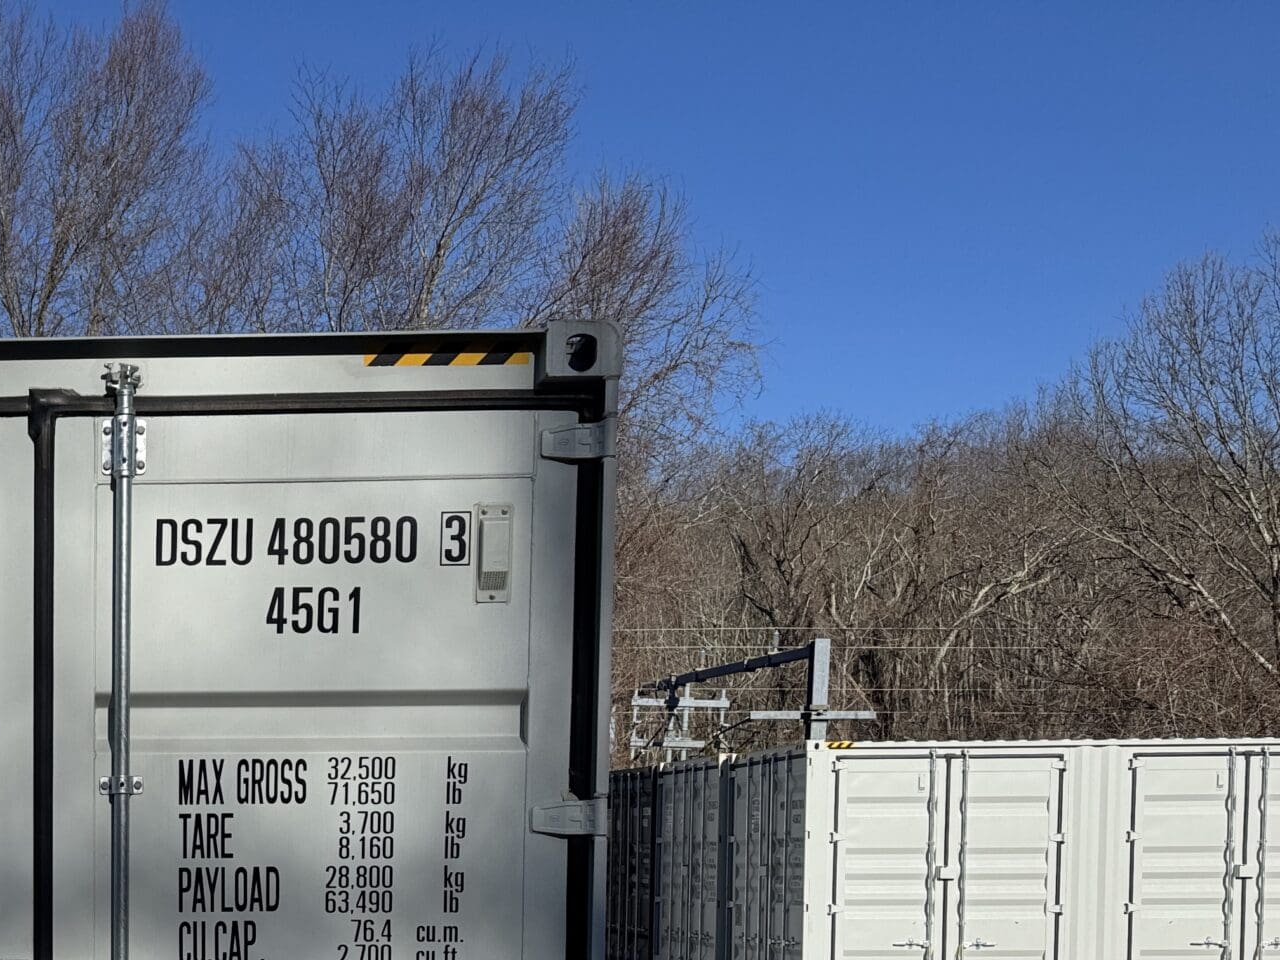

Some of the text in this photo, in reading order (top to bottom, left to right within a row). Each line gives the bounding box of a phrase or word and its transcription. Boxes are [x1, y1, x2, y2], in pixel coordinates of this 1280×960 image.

[155, 515, 466, 566] DSZU 480580 3
[266, 586, 361, 634] 45G1
[178, 756, 468, 805] MAX GROSS 32,500 kg
[328, 782, 462, 806] 71,650 lb
[179, 811, 466, 859] TARE 3,700 kg
[338, 836, 460, 861] 8,160 lb
[179, 865, 464, 913] PAYLOAD 28,800 kg
[325, 891, 459, 915] 63,490 lb
[351, 919, 392, 943] 76.4
[416, 925, 464, 943] cu.m.
